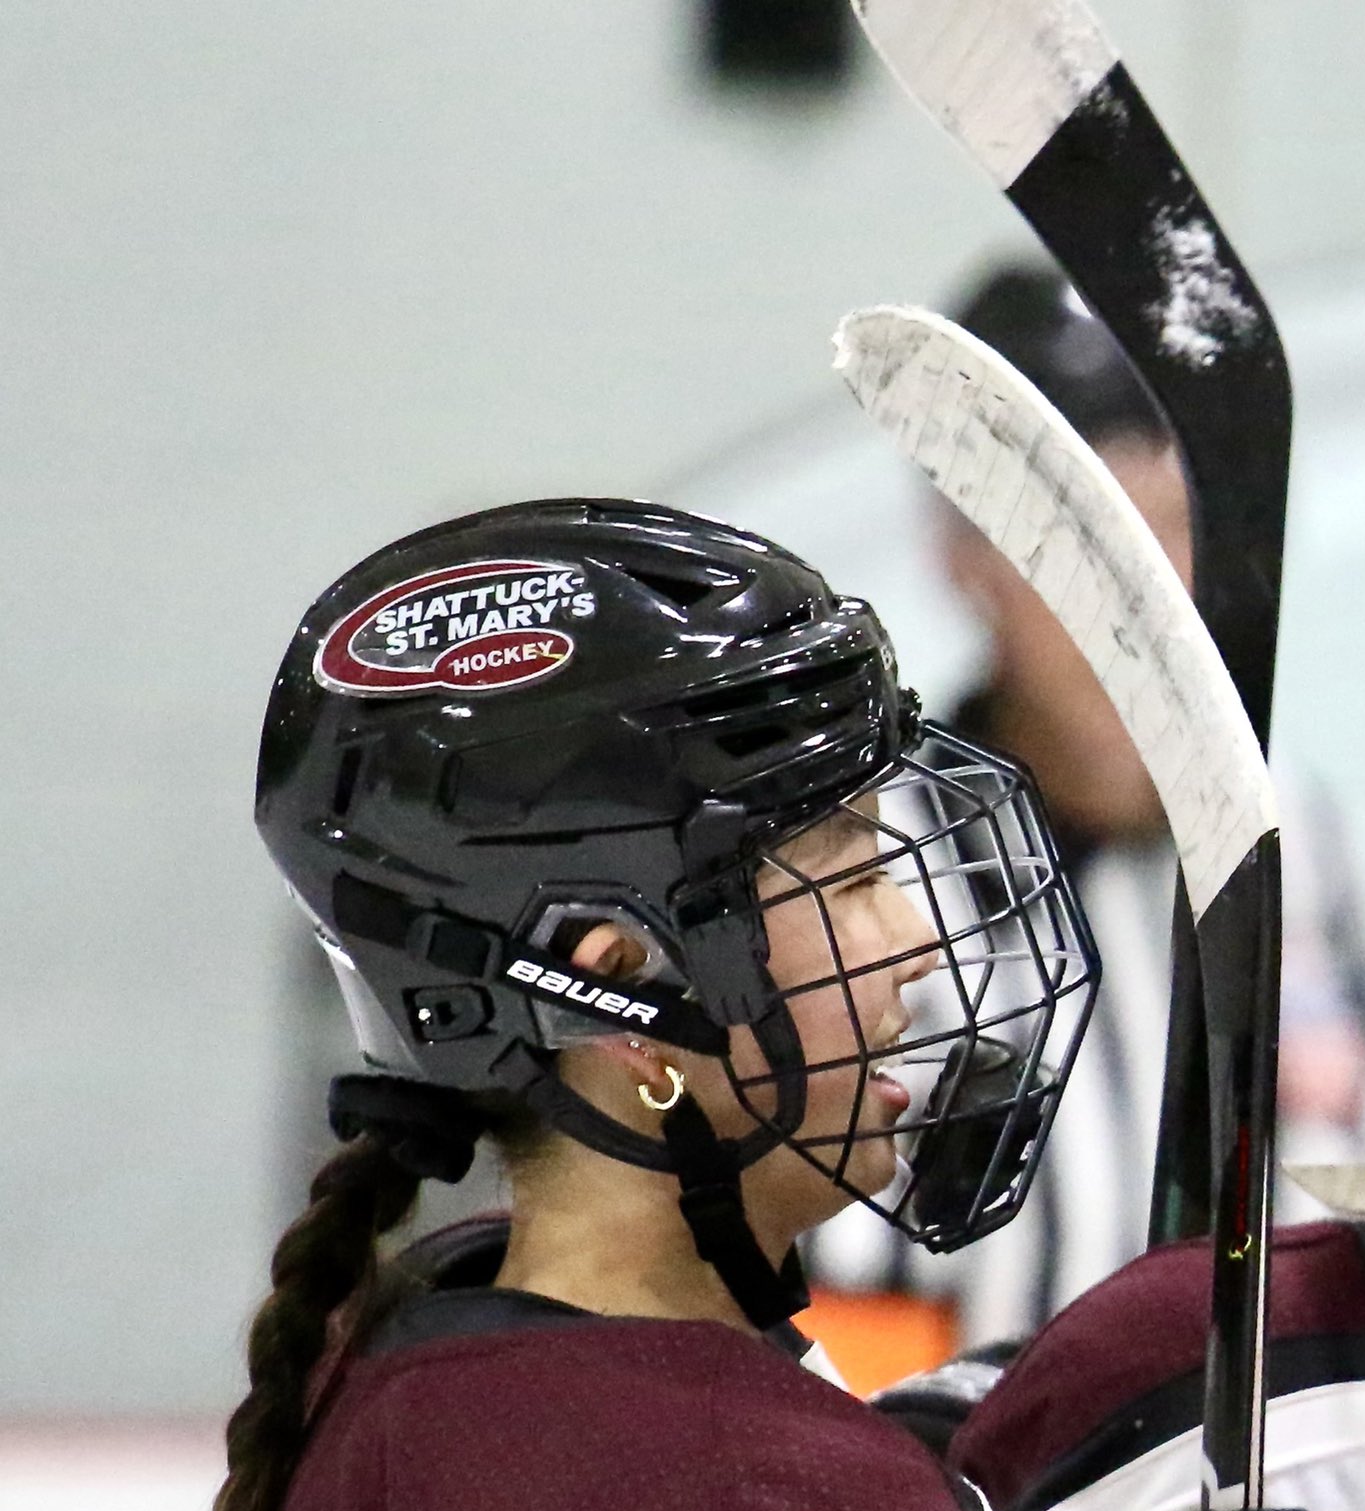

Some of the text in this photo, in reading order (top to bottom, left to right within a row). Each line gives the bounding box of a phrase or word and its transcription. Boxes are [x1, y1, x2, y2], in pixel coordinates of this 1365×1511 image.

[373, 571, 586, 634] SHATTUCK-
[386, 592, 596, 656] ST. MARY'S
[452, 640, 555, 676] HOCKEY
